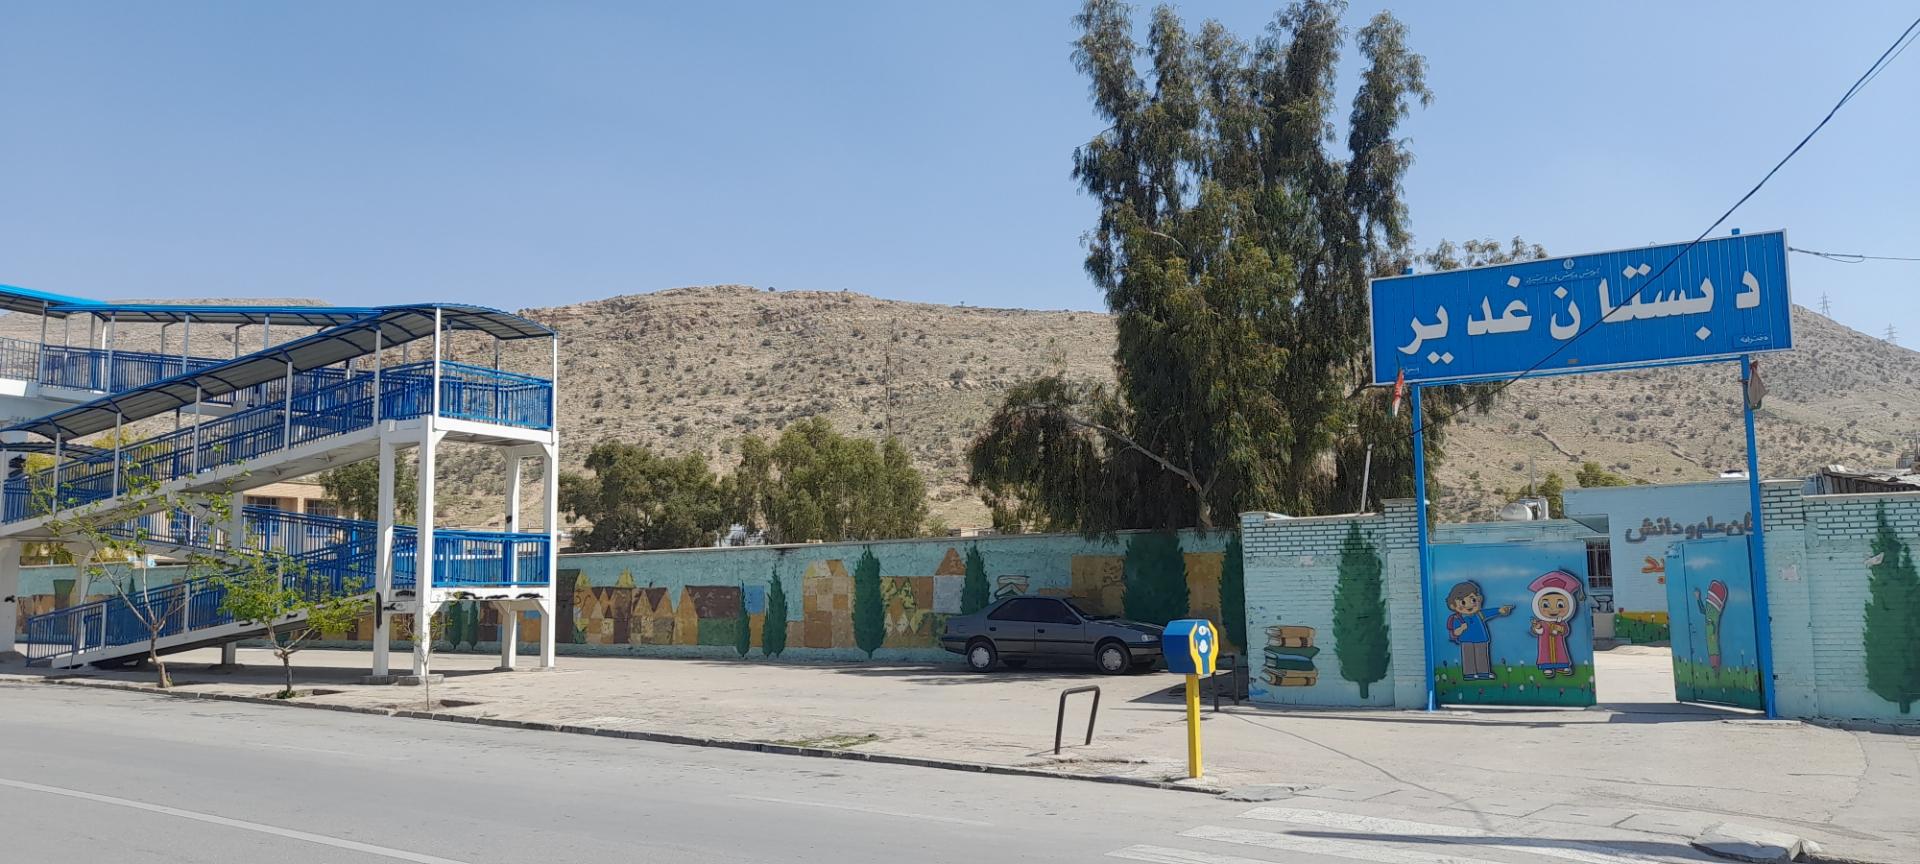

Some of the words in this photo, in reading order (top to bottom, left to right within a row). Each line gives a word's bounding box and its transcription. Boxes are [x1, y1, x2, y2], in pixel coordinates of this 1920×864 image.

[1398, 275, 1533, 364] غدیر
[1549, 263, 1761, 341] دبستان
[1625, 516, 1684, 544] دانش
[1685, 521, 1698, 540] و
